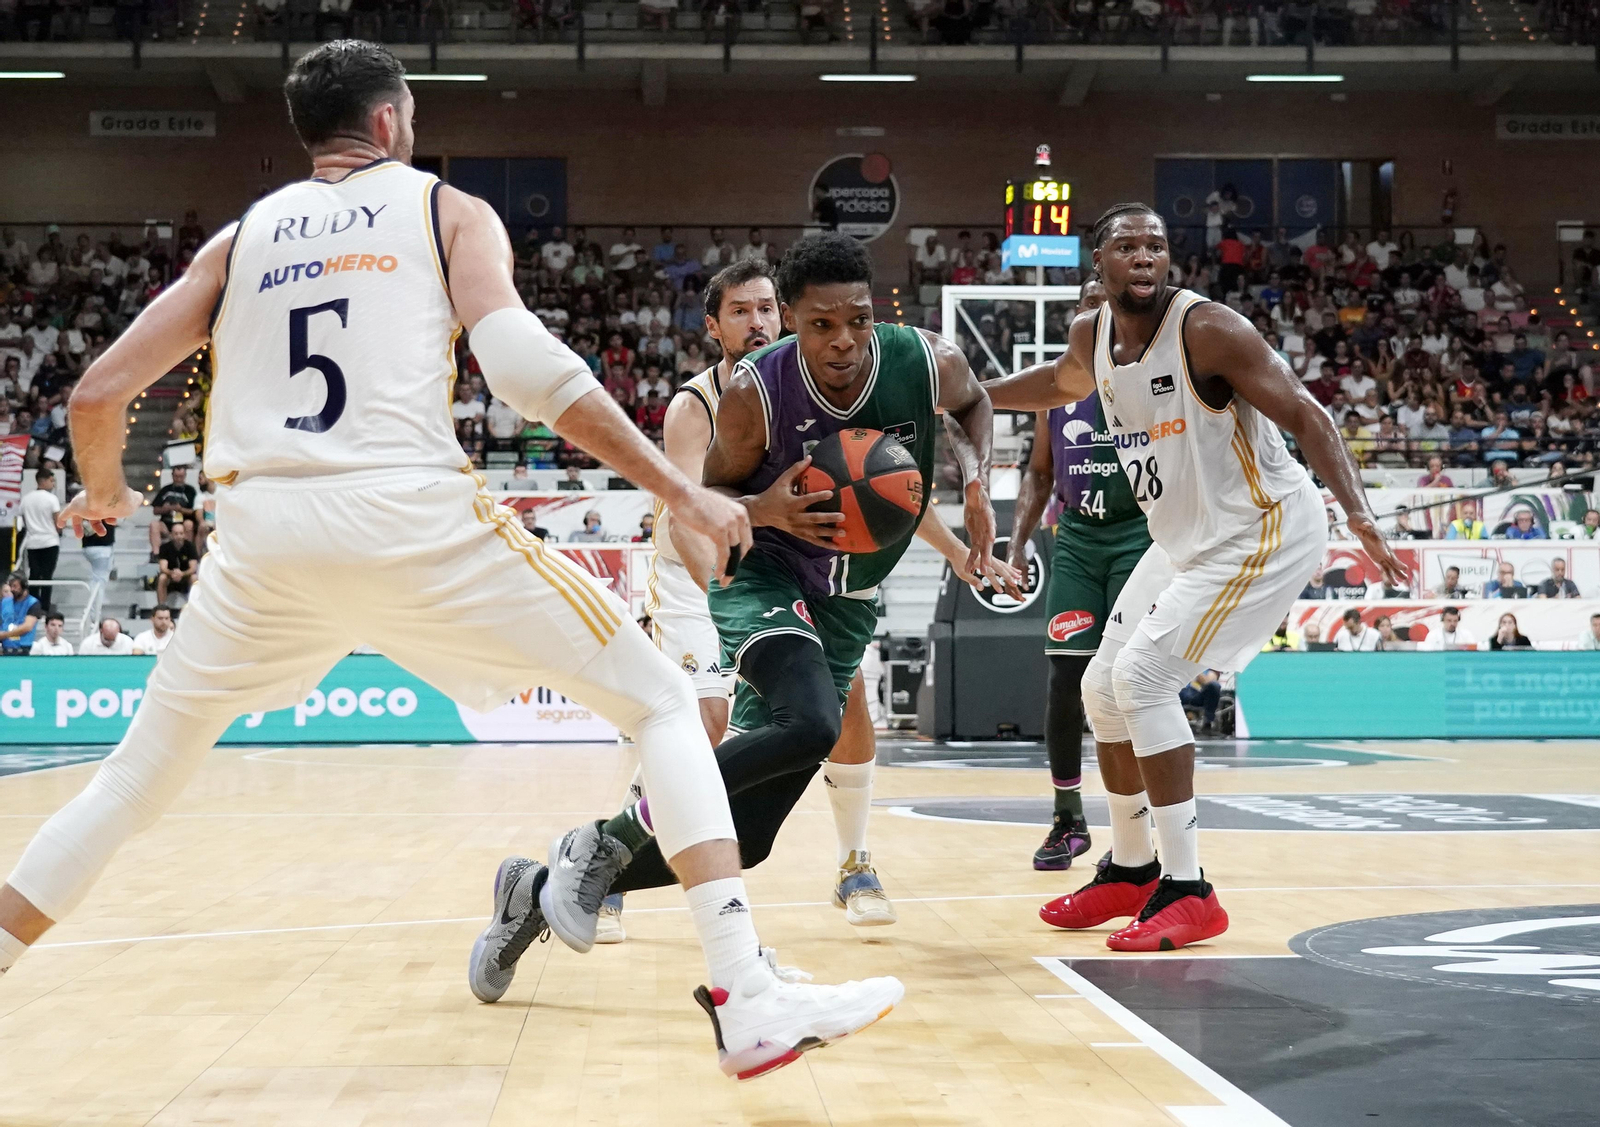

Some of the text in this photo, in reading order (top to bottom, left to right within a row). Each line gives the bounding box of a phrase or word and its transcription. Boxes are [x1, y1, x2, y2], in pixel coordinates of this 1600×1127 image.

[101, 116, 205, 131] Grada Este
[1506, 119, 1563, 134] Grada
[835, 198, 891, 213] ndesa
[1033, 204, 1070, 235] 14
[273, 203, 388, 244] RUDY
[258, 253, 398, 294] AUTOHERO
[284, 297, 350, 434] 5
[1090, 429, 1114, 443] Unic
[1125, 455, 1164, 503] 28
[1079, 489, 1107, 520] 34
[828, 553, 851, 597] 11
[294, 686, 418, 727] poco
[537, 709, 592, 724] seguros
